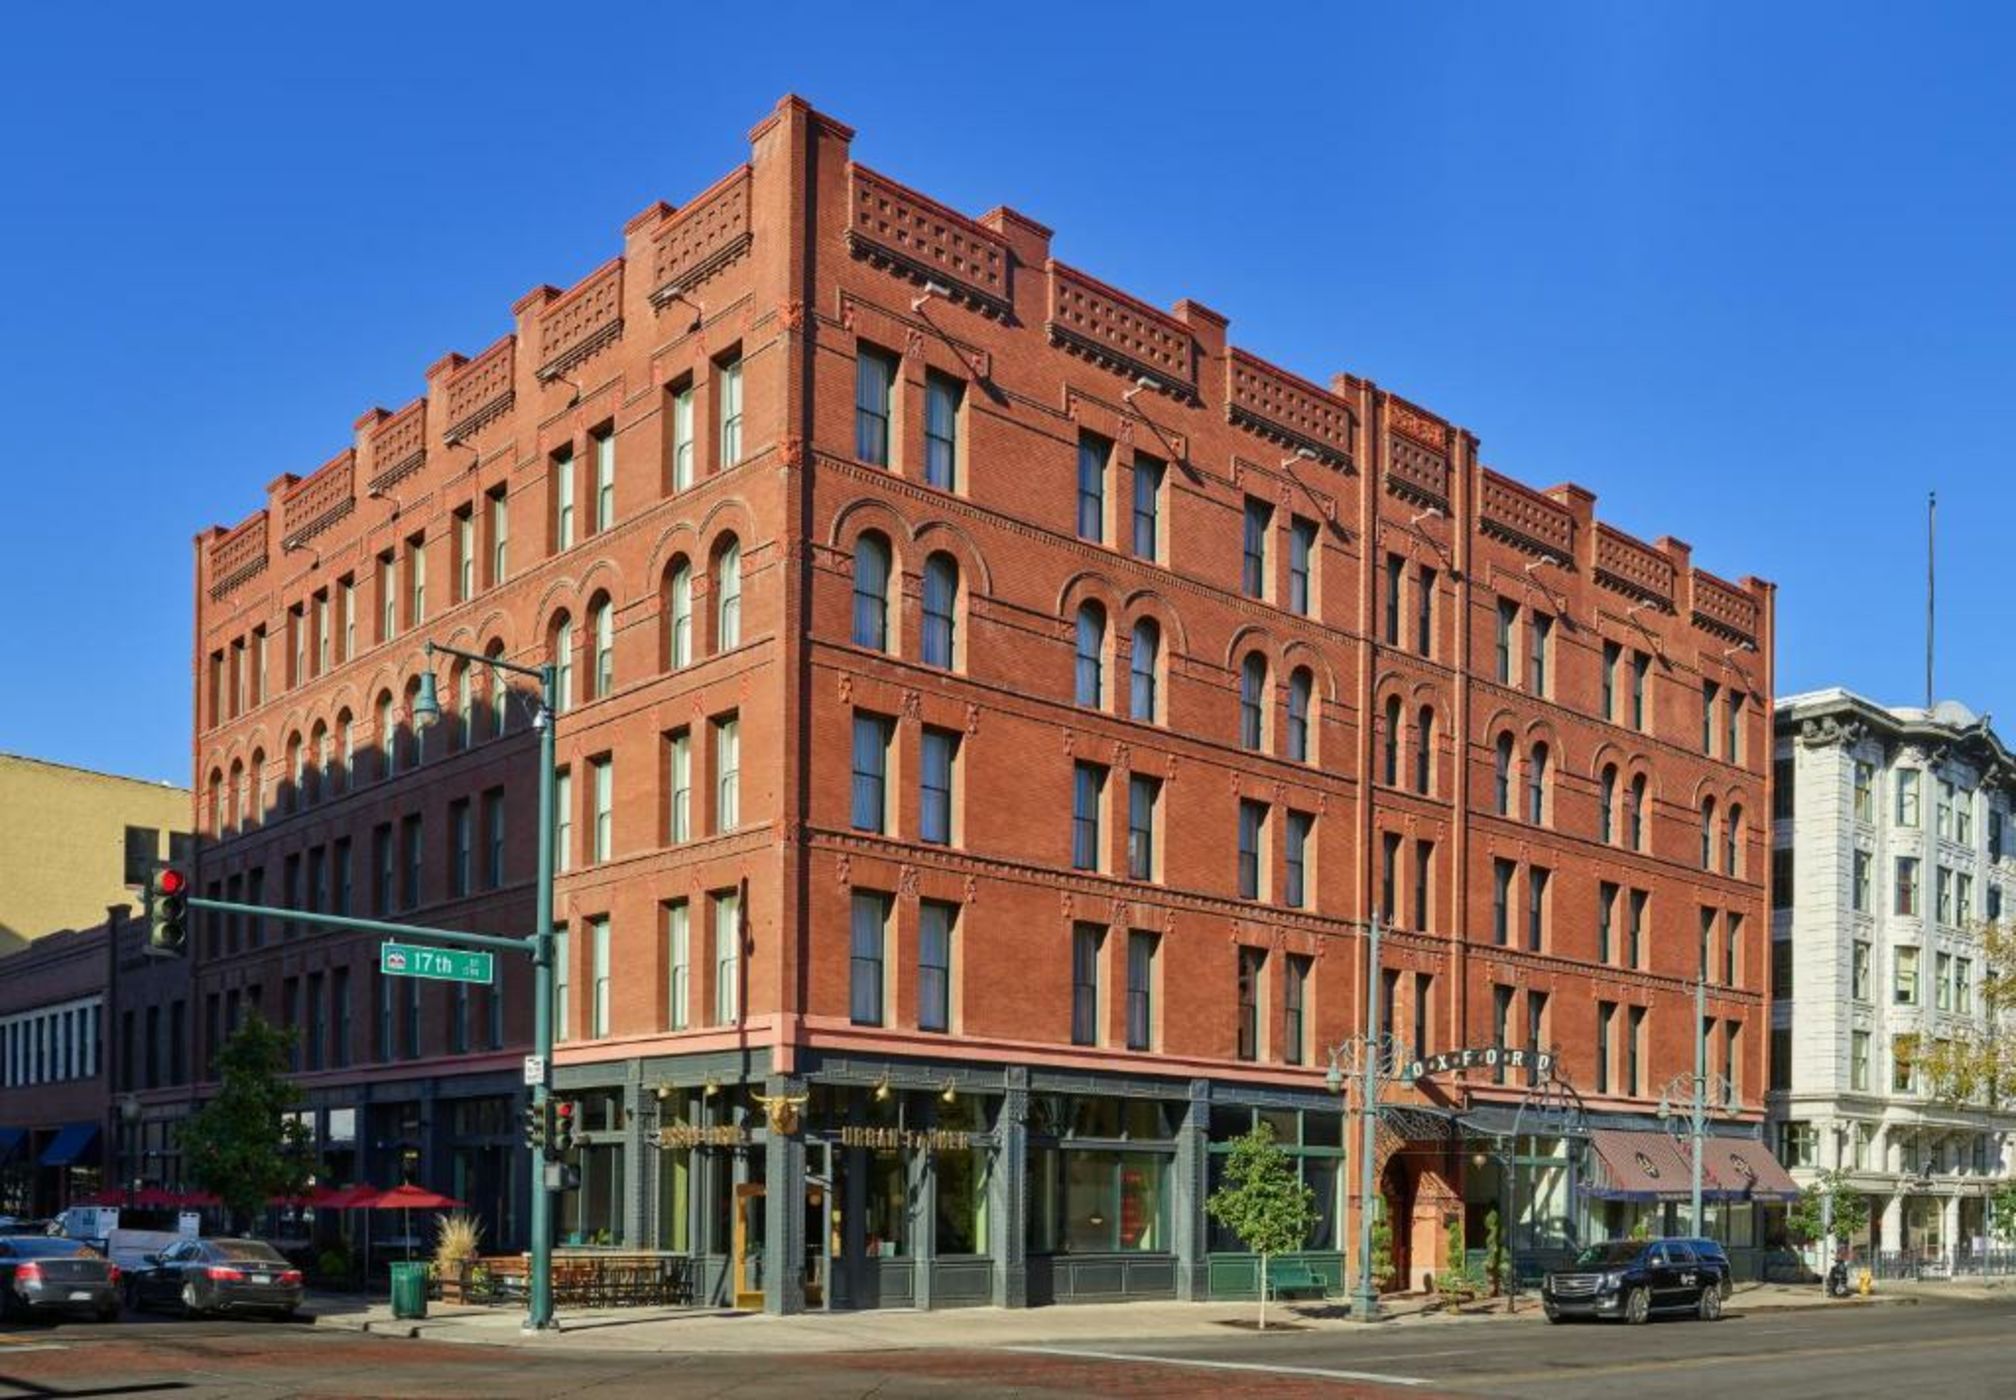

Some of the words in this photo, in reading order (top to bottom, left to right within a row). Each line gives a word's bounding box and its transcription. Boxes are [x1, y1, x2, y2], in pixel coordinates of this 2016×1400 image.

[415, 952, 452, 974] 17th
[1412, 1049, 1550, 1077] OXFORD
[842, 1126, 898, 1147] URBAN
